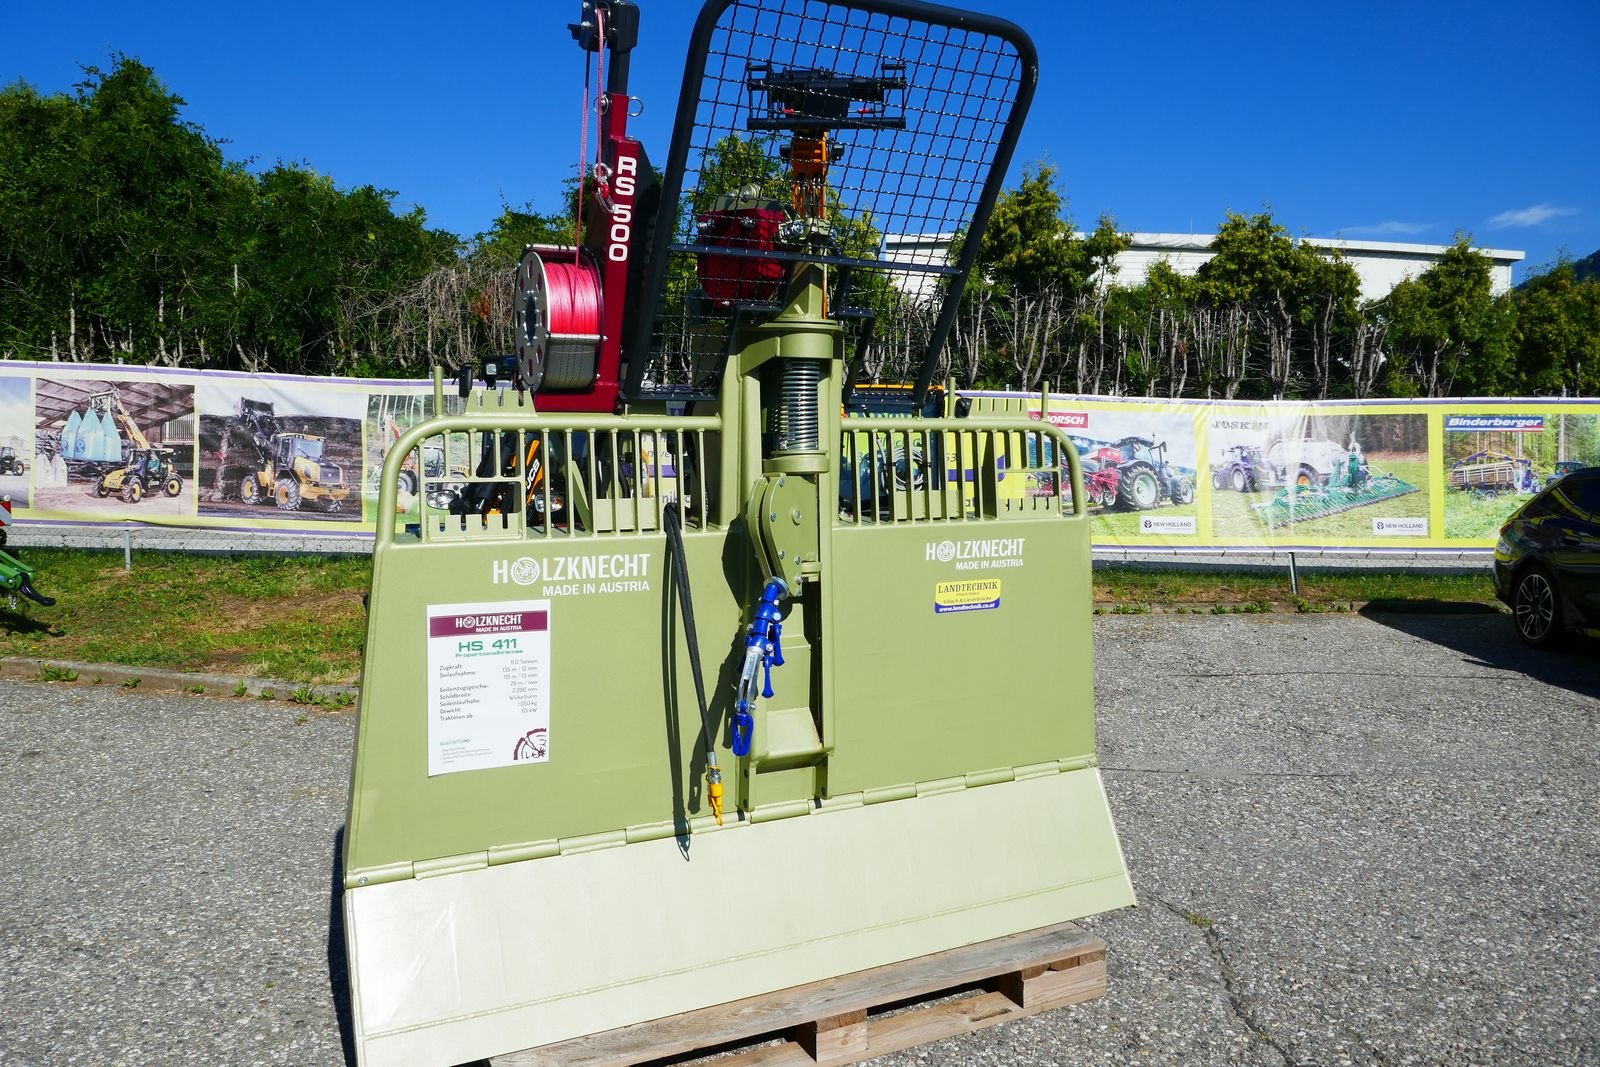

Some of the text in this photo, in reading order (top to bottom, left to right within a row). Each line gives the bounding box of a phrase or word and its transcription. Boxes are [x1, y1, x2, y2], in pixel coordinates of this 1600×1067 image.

[608, 156, 637, 262] RS 500
[1448, 417, 1542, 428] Binderberger
[526, 458, 540, 490] JCB
[925, 538, 1025, 562] HOLZKNECHT
[493, 553, 650, 586] HOLZKNECHT
[955, 558, 1024, 570] MADE IN AUSTRIA
[543, 580, 650, 596] MADE IN AUSTRIA
[938, 581, 998, 593] LANDTECHNIK
[455, 614, 522, 628] HOLZKNECHT
[459, 638, 517, 652] HS 411
